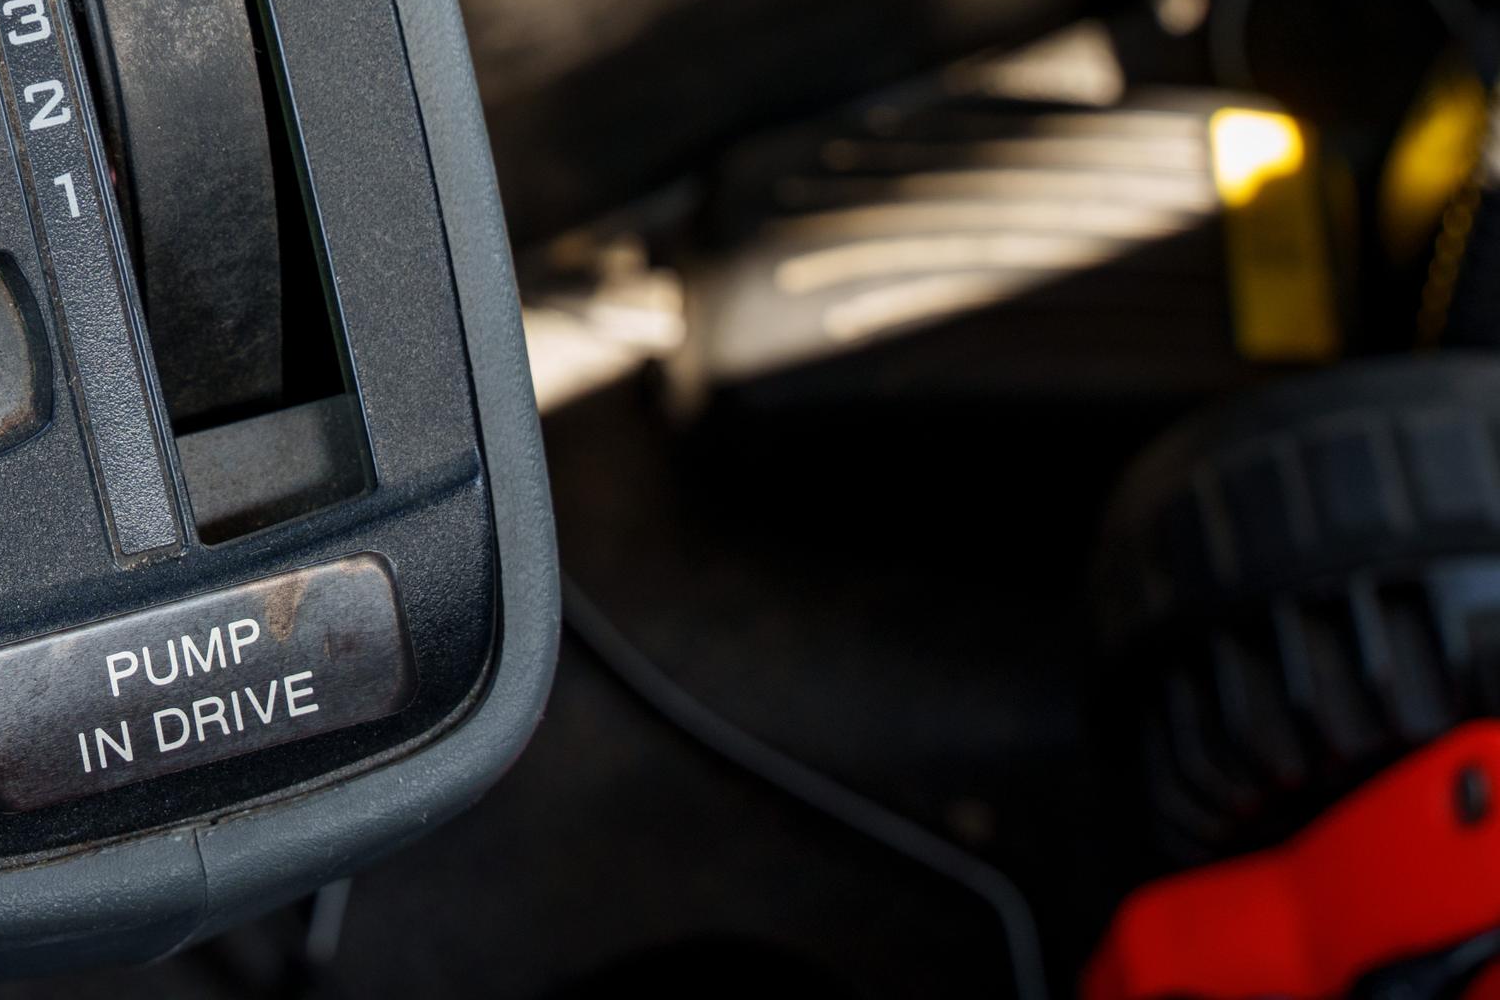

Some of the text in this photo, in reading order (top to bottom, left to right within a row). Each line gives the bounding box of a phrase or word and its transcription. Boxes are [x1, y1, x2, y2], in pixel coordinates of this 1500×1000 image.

[24, 80, 71, 131] 2
[54, 171, 81, 218] 1
[106, 618, 260, 697] PUMP
[78, 671, 319, 773] IN DRIVE
